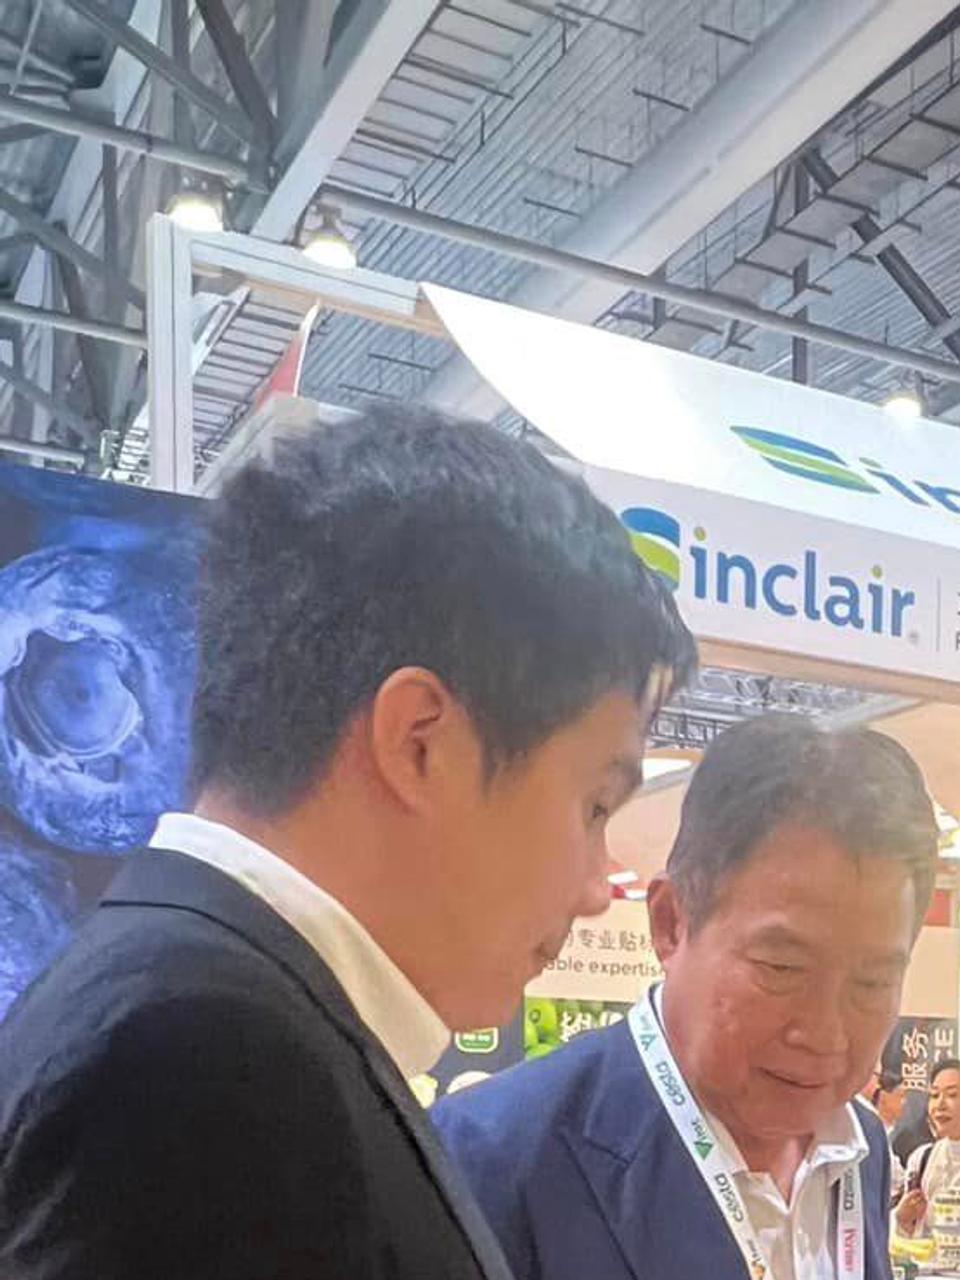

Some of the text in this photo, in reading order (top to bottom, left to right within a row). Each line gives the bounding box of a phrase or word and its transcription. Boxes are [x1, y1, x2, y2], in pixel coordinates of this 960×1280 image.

[567, 928, 651, 952] 专业贴
[588, 959, 664, 977] expertis
